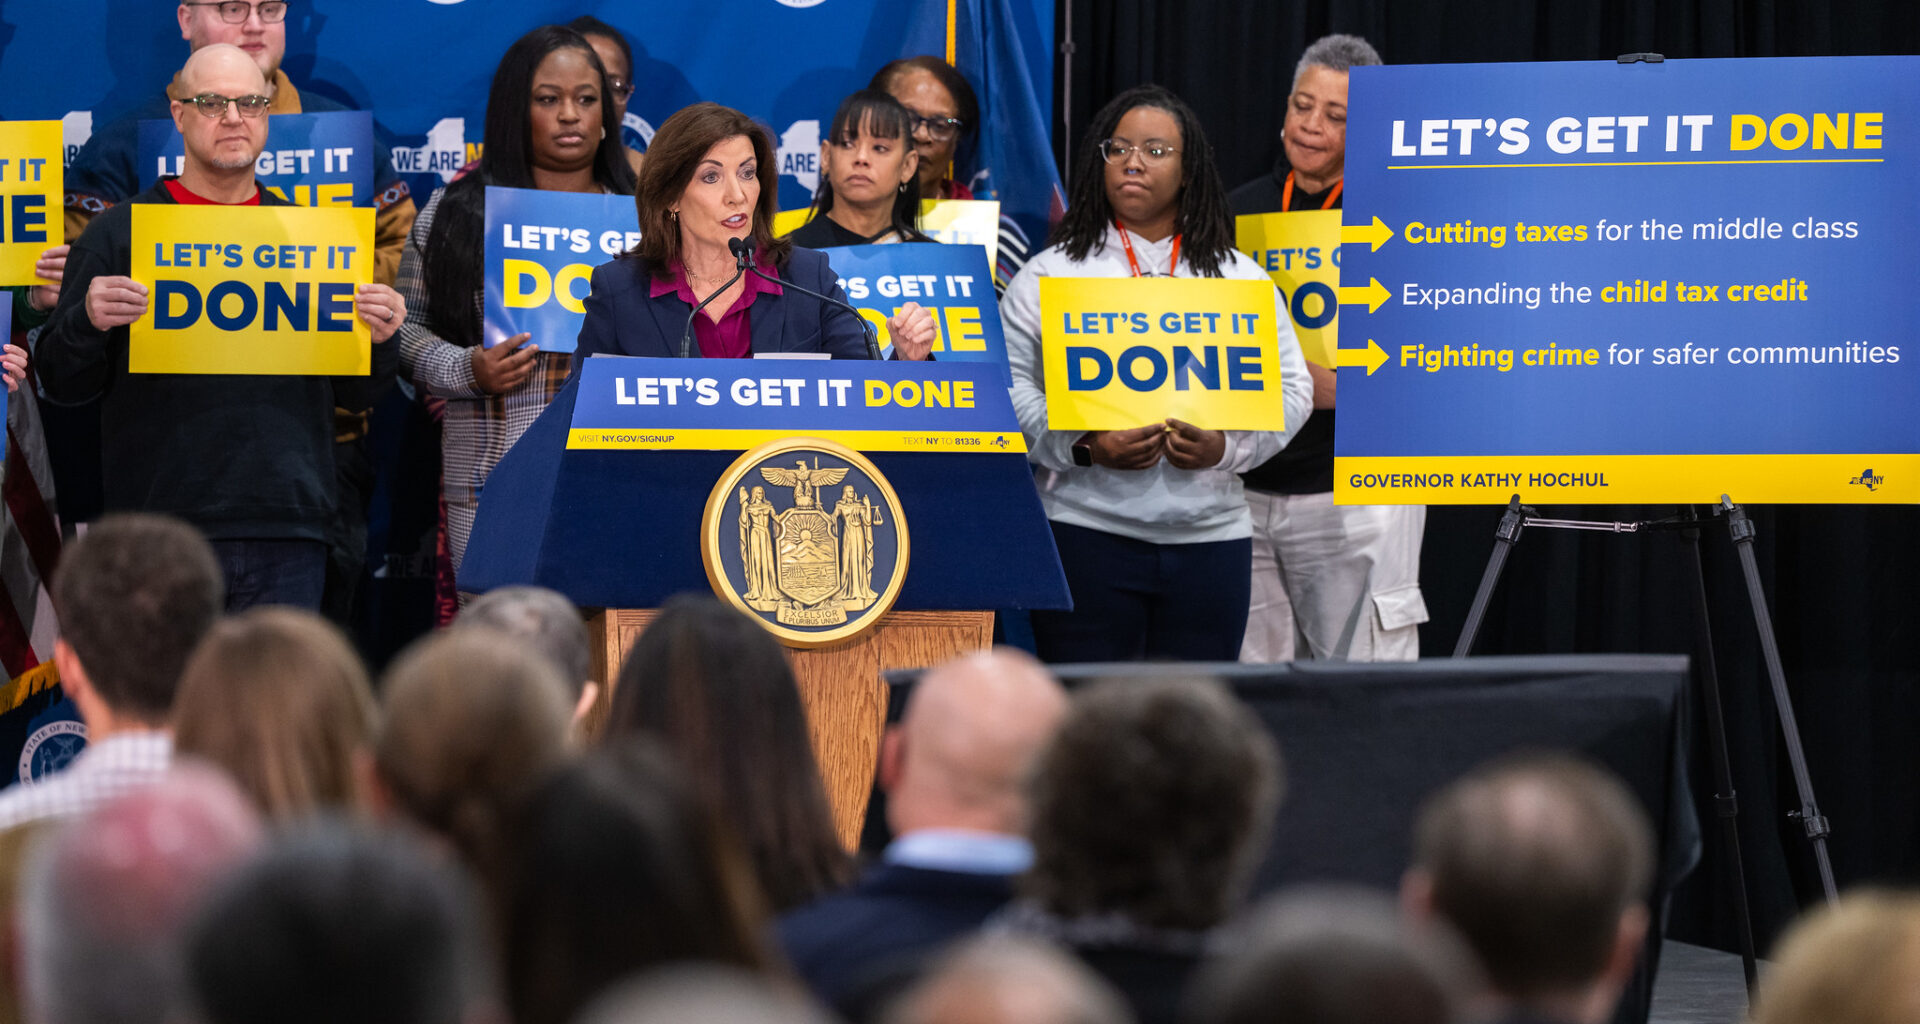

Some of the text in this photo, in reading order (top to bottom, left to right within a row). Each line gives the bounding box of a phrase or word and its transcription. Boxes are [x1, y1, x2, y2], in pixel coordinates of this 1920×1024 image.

[1391, 112, 1883, 157] LET'S GET IT DONE
[19, 158, 46, 182] IT
[255, 147, 354, 175] GET IT
[396, 142, 485, 171] WE ARE N
[784, 152, 816, 172] ARE
[503, 223, 643, 256] LET'S GE
[1404, 216, 1859, 248] Cutting taxes for the middle class
[155, 243, 356, 269] LET'S GET IT
[503, 258, 592, 314] DO
[876, 275, 937, 298] GET
[945, 275, 973, 297] IT
[1402, 277, 1808, 310] Expanding the child tax credit
[153, 280, 354, 332] DONE
[1063, 311, 1259, 335] LET'S GET IT
[1066, 345, 1264, 392] DONE
[1400, 340, 1900, 373] Fighting crime for safer communities
[615, 377, 975, 408] LET'S GET IT DONE
[578, 434, 675, 443] VISIT NY.GOV/SIGNUP
[903, 437, 981, 446] TEXT NY TO 81336
[1350, 472, 1609, 488] GOVERNOR KATHY HOCHUL
[1873, 475, 1885, 485] NY
[784, 609, 838, 618] EXCELSIOR
[25, 729, 48, 754] STATE
[49, 724, 61, 733] OF
